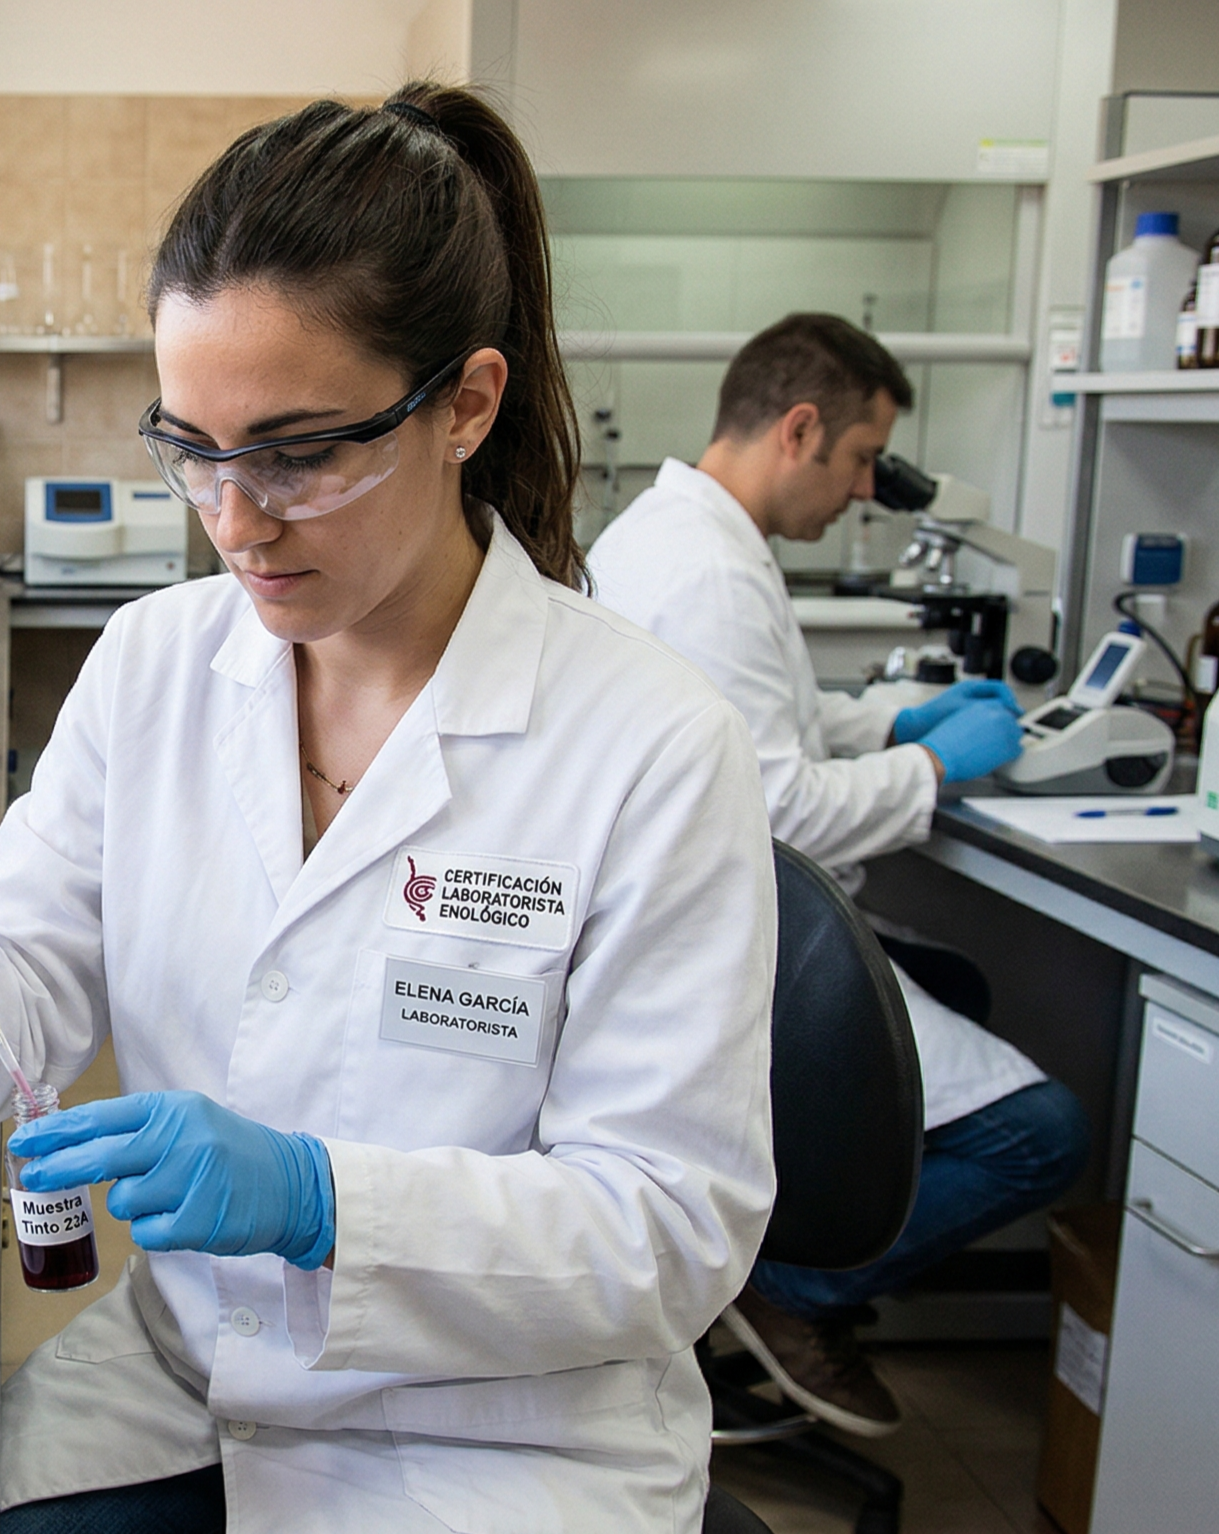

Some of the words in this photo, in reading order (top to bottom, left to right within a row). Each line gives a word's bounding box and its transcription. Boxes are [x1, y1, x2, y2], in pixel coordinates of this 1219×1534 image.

[444, 868, 562, 896] CERTIFICACIÓN
[441, 887, 565, 915] LABORATORISTA
[439, 904, 529, 928] ENOLÓGICO
[395, 981, 454, 1004] ELENA
[459, 991, 529, 1016] GARCÍA
[401, 1008, 518, 1039] LABORATORISTA
[23, 1196, 82, 1215] Muestra
[22, 1220, 60, 1234] Tinto
[64, 1211, 89, 1231] 23A
